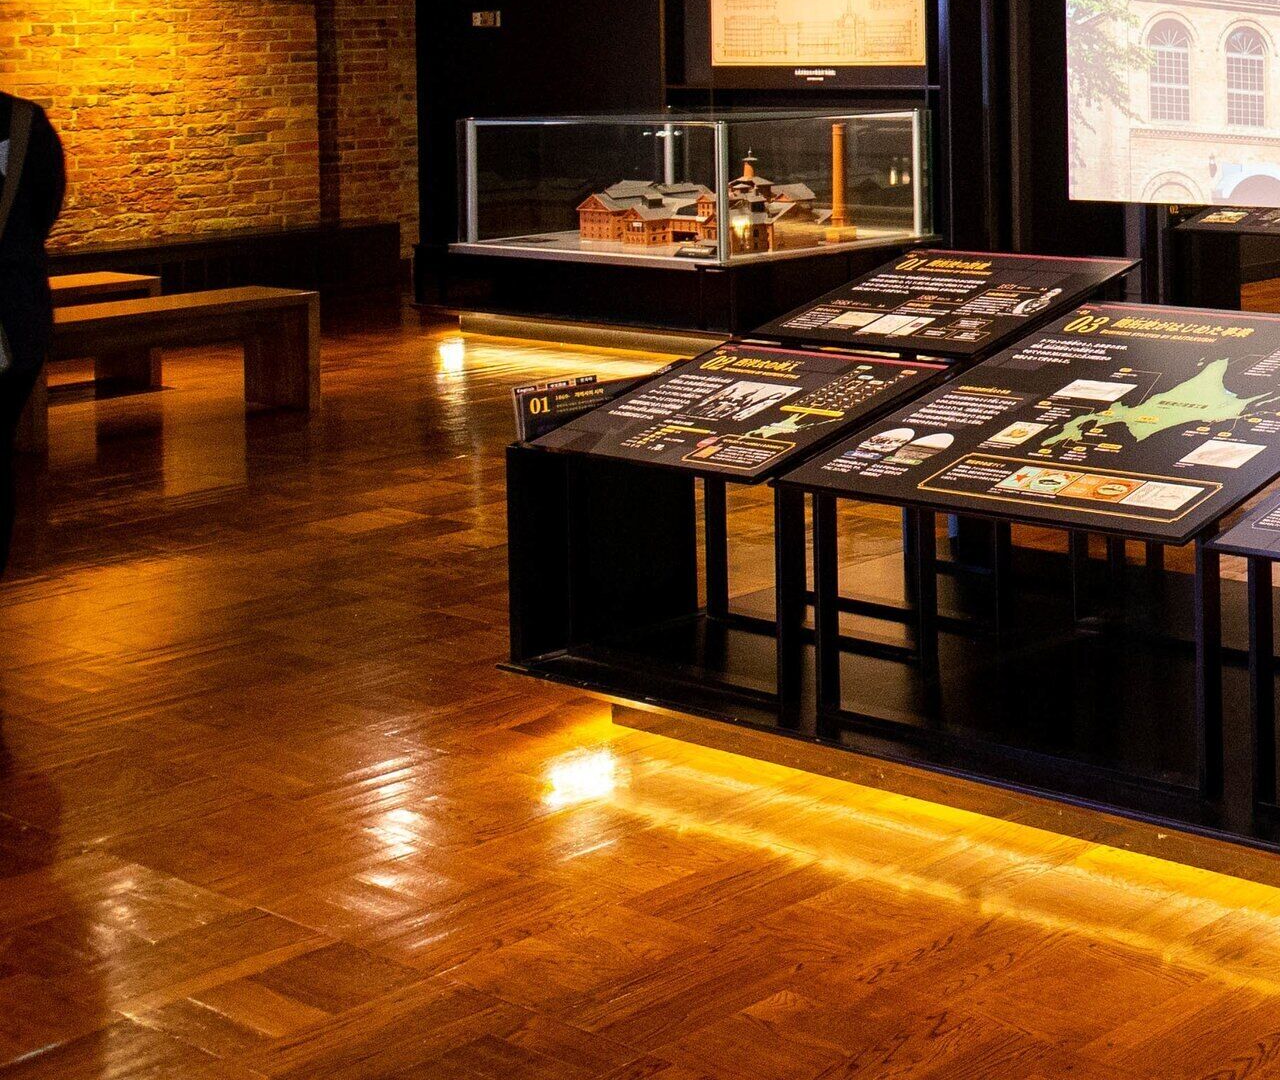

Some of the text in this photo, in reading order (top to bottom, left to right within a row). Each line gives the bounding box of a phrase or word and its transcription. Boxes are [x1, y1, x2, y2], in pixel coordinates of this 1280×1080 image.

[895, 258, 928, 271] 01
[1063, 315, 1111, 333] 03
[699, 355, 737, 370] 02
[529, 396, 551, 415] 01
